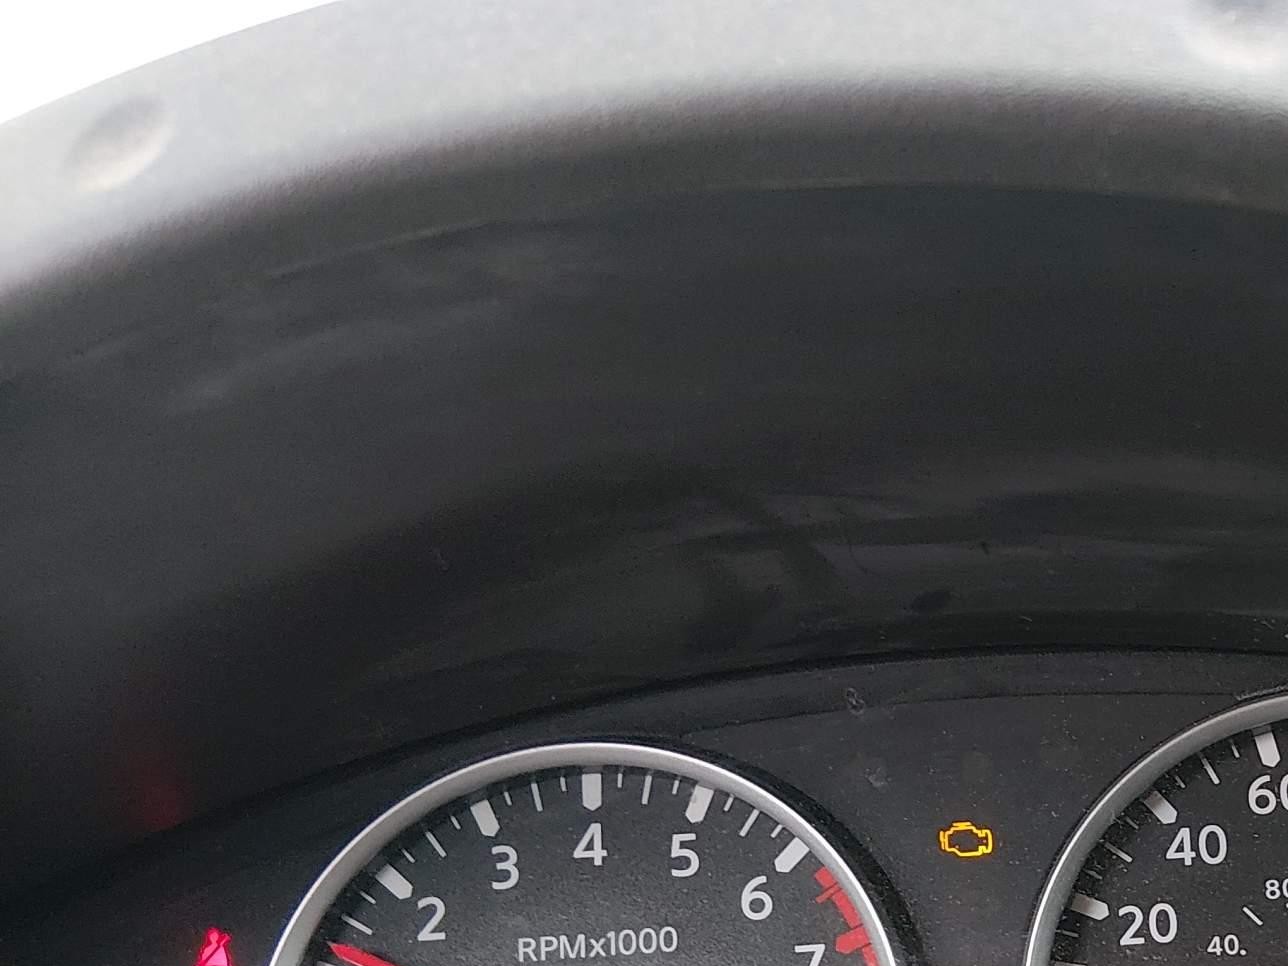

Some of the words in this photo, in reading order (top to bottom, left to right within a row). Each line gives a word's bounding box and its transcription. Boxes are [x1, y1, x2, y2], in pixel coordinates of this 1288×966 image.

[573, 823, 607, 867] 4
[670, 834, 700, 878] 5
[1165, 824, 1228, 867] 40
[491, 845, 520, 890] 3
[416, 896, 446, 942] 2
[741, 876, 774, 921] 6
[517, 926, 679, 963] RPMx1000
[1117, 903, 1178, 946] 20
[1206, 934, 1239, 957] 40
